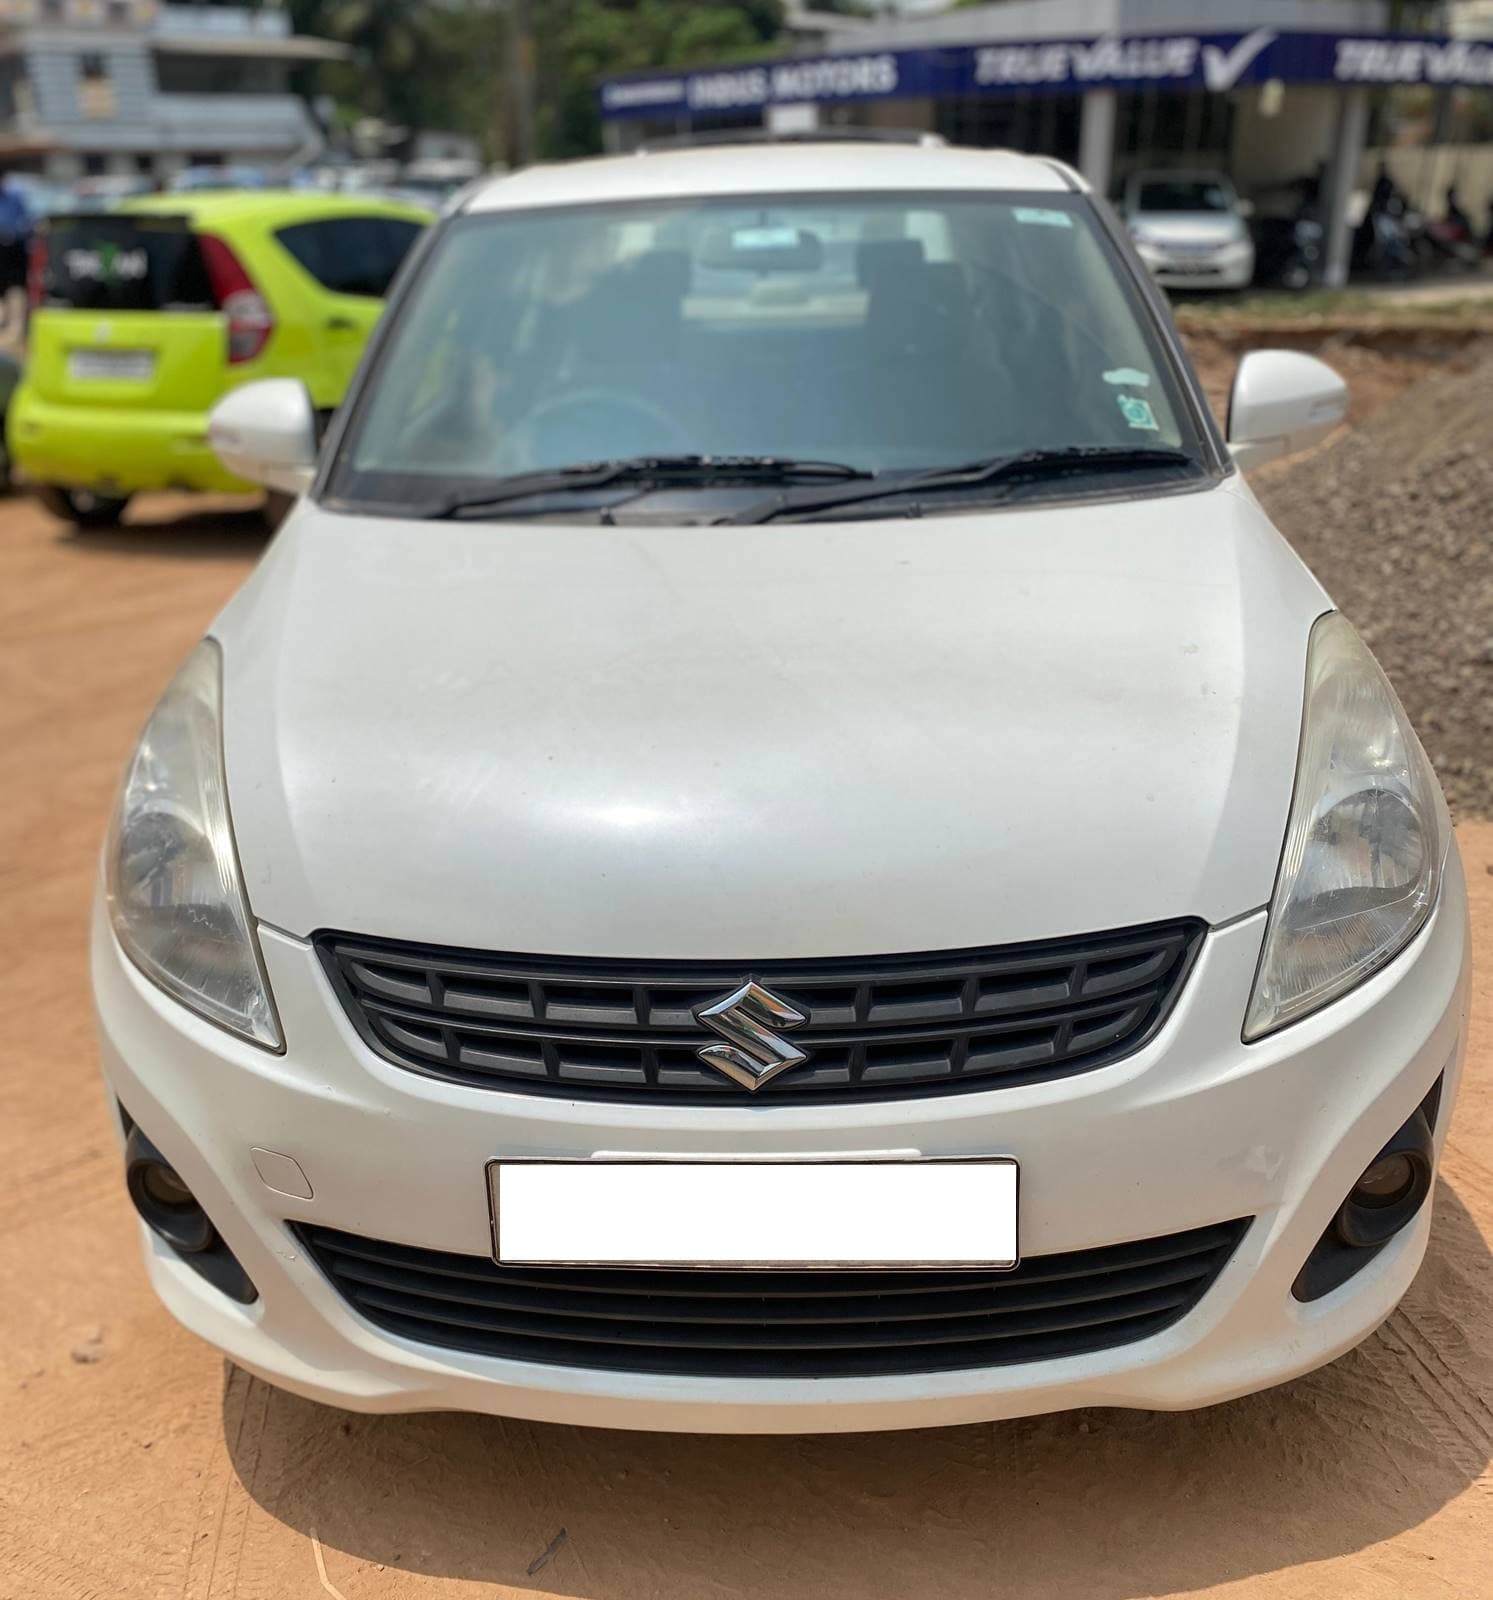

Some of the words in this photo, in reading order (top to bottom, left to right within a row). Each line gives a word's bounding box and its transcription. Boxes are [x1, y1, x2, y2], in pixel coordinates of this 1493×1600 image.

[974, 44, 1070, 85] TRUE
[1071, 34, 1200, 81] VALUE
[1334, 39, 1424, 83] TRUE
